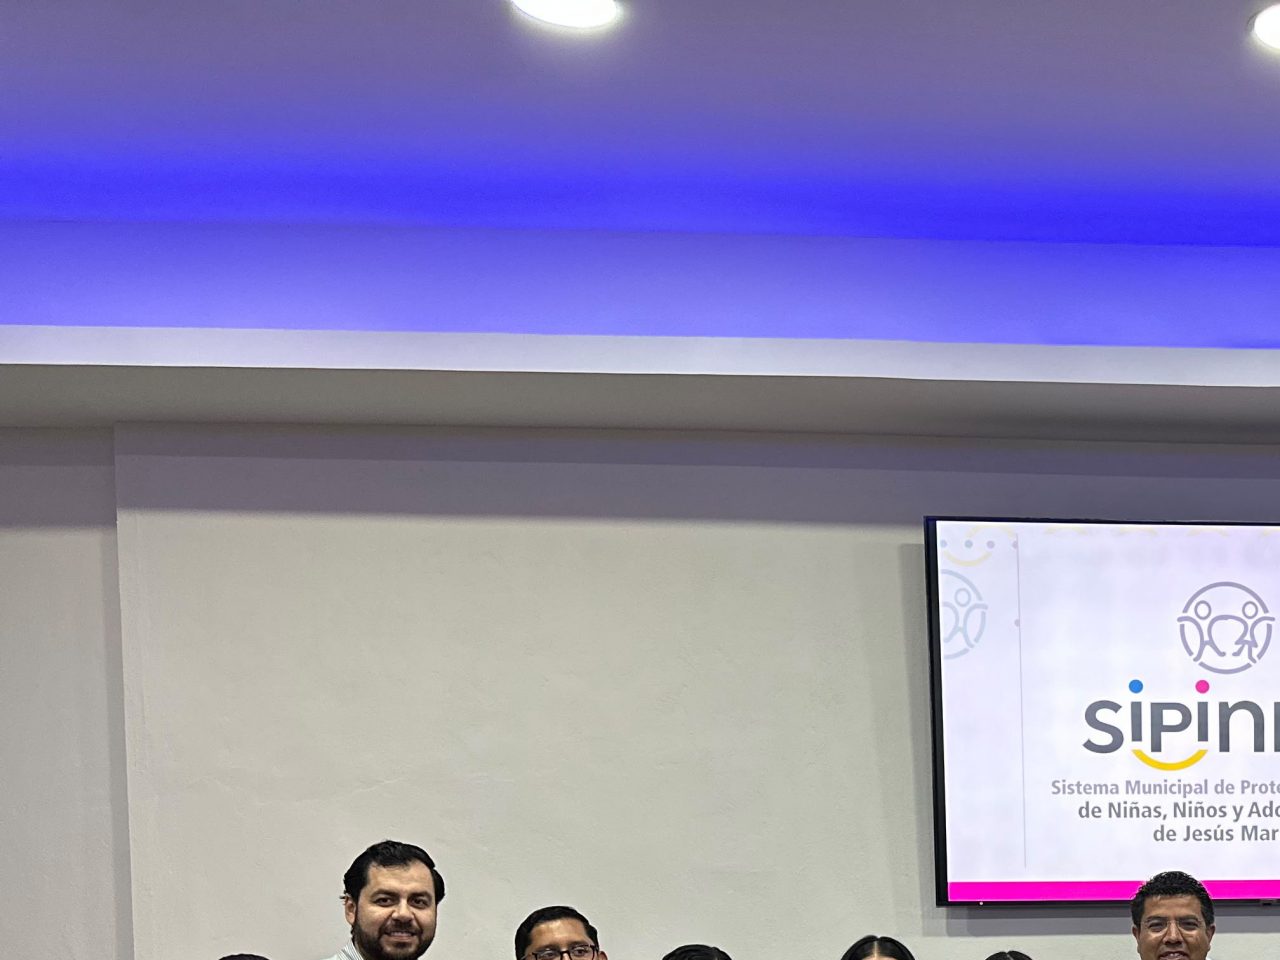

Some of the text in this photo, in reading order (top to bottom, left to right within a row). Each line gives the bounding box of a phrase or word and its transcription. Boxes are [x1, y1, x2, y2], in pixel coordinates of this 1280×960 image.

[1051, 779, 1120, 795] Sistema
[1125, 779, 1209, 798] Municipal
[1214, 779, 1235, 795] de
[1078, 801, 1102, 818] de
[1108, 801, 1168, 821] Niñas,
[1173, 801, 1227, 818] Niños
[1232, 804, 1244, 822] y
[1153, 824, 1177, 841] de
[1183, 824, 1234, 842] Jesús
